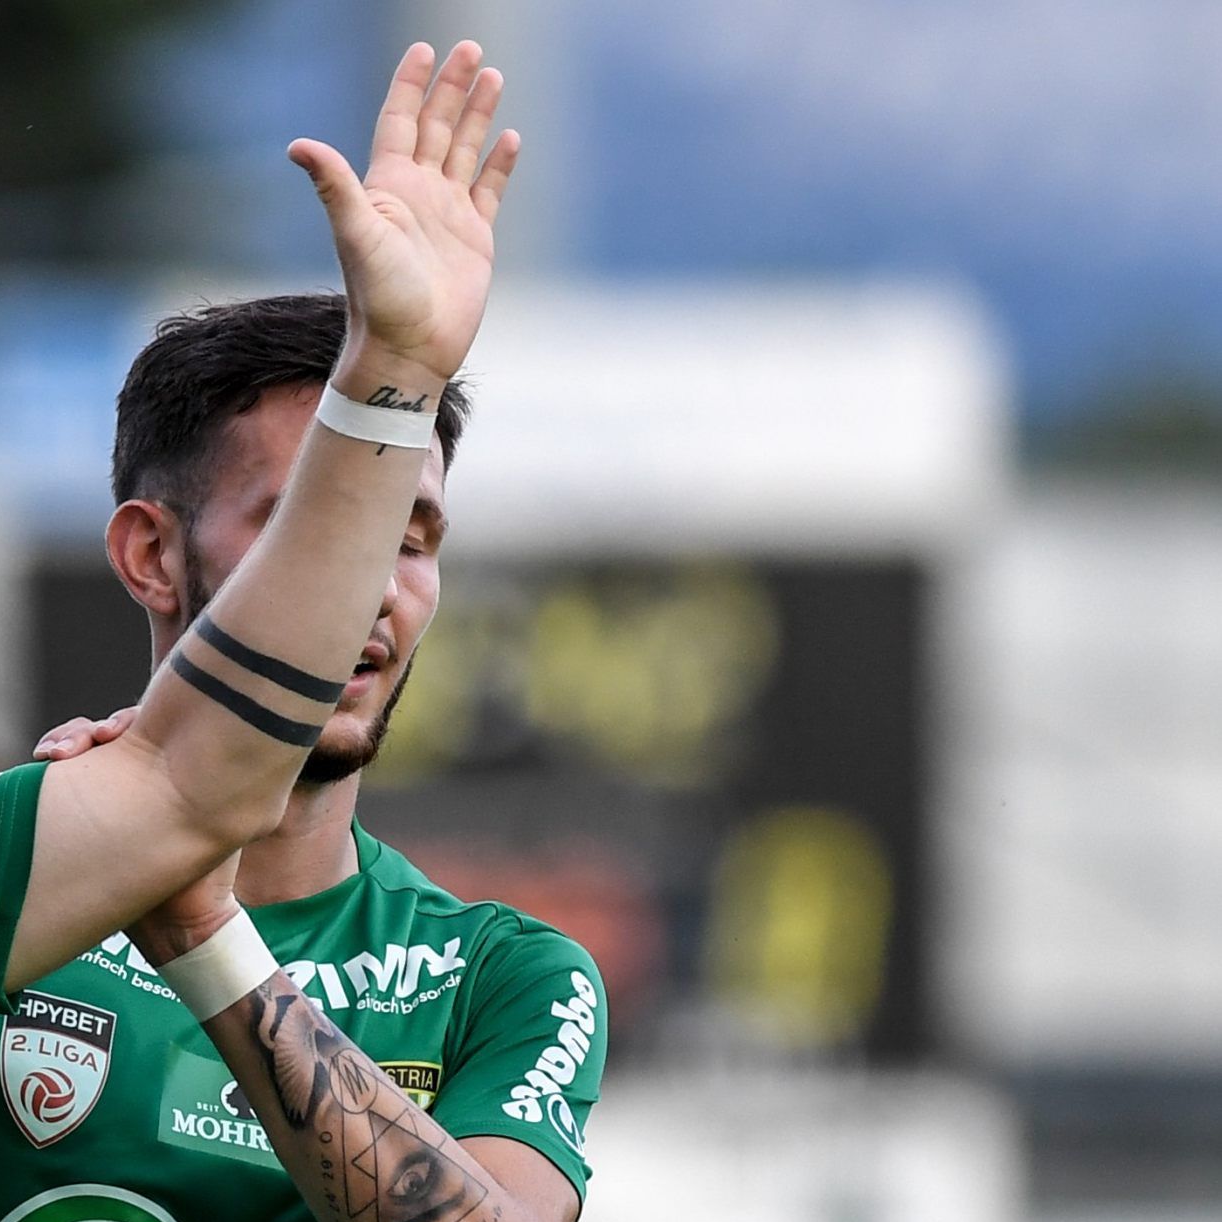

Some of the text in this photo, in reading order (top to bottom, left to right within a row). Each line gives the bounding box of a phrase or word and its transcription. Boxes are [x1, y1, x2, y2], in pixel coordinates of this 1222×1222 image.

[10, 1035, 98, 1072] 2. LIGA
[385, 1068, 434, 1090] STRIA
[196, 1102, 219, 1113] SEIT
[172, 1108, 275, 1153] MOHR
